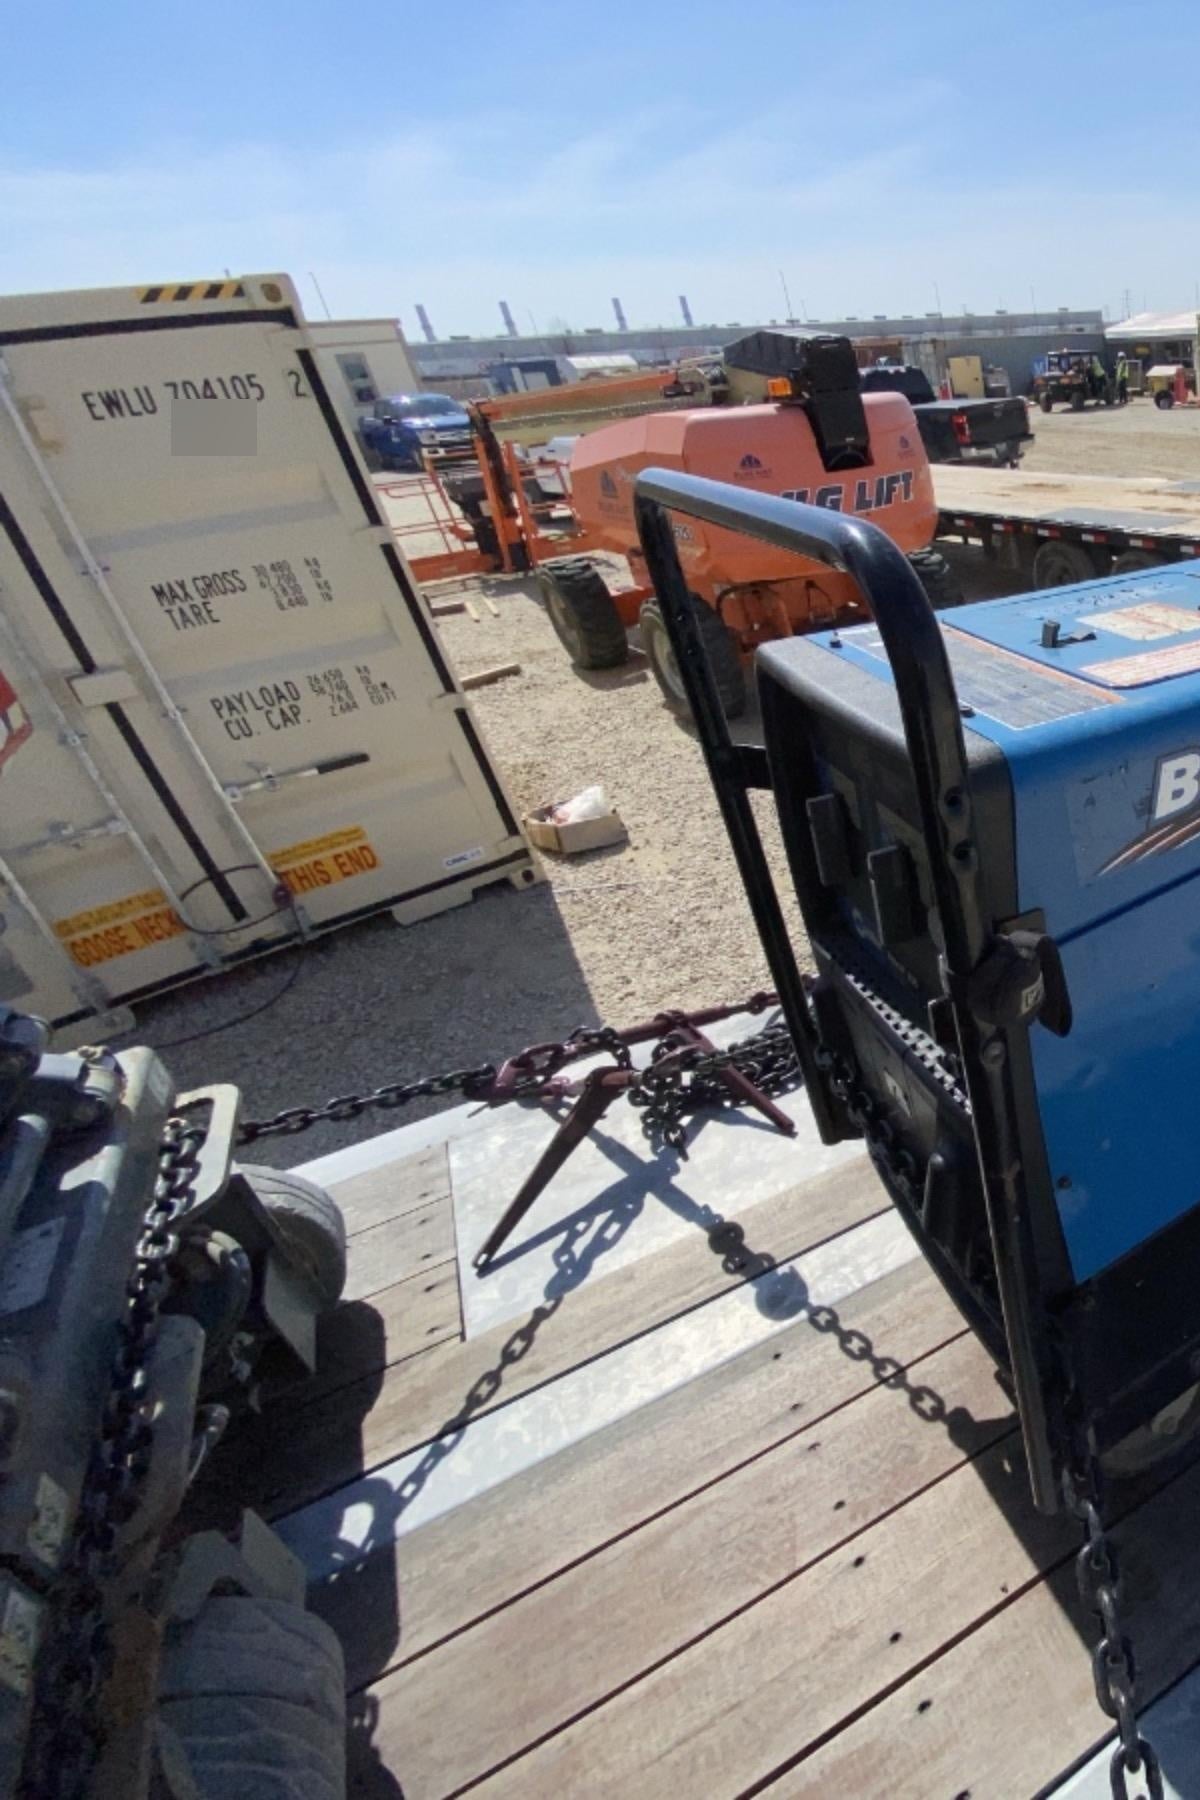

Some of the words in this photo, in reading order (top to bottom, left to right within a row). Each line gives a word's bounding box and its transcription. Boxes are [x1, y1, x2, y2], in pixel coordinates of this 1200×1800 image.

[81, 386, 158, 421] EWLU
[287, 371, 308, 397] 2
[854, 470, 914, 513] LIFT
[151, 579, 194, 607] MAX
[192, 569, 247, 600] GROSS
[164, 601, 221, 631] TARE
[210, 681, 301, 719] PAYLOAD
[223, 715, 261, 741] CU.
[265, 704, 312, 731] CAP.
[283, 860, 332, 894] THIS
[334, 845, 378, 880] END
[69, 925, 134, 968] GOOSE
